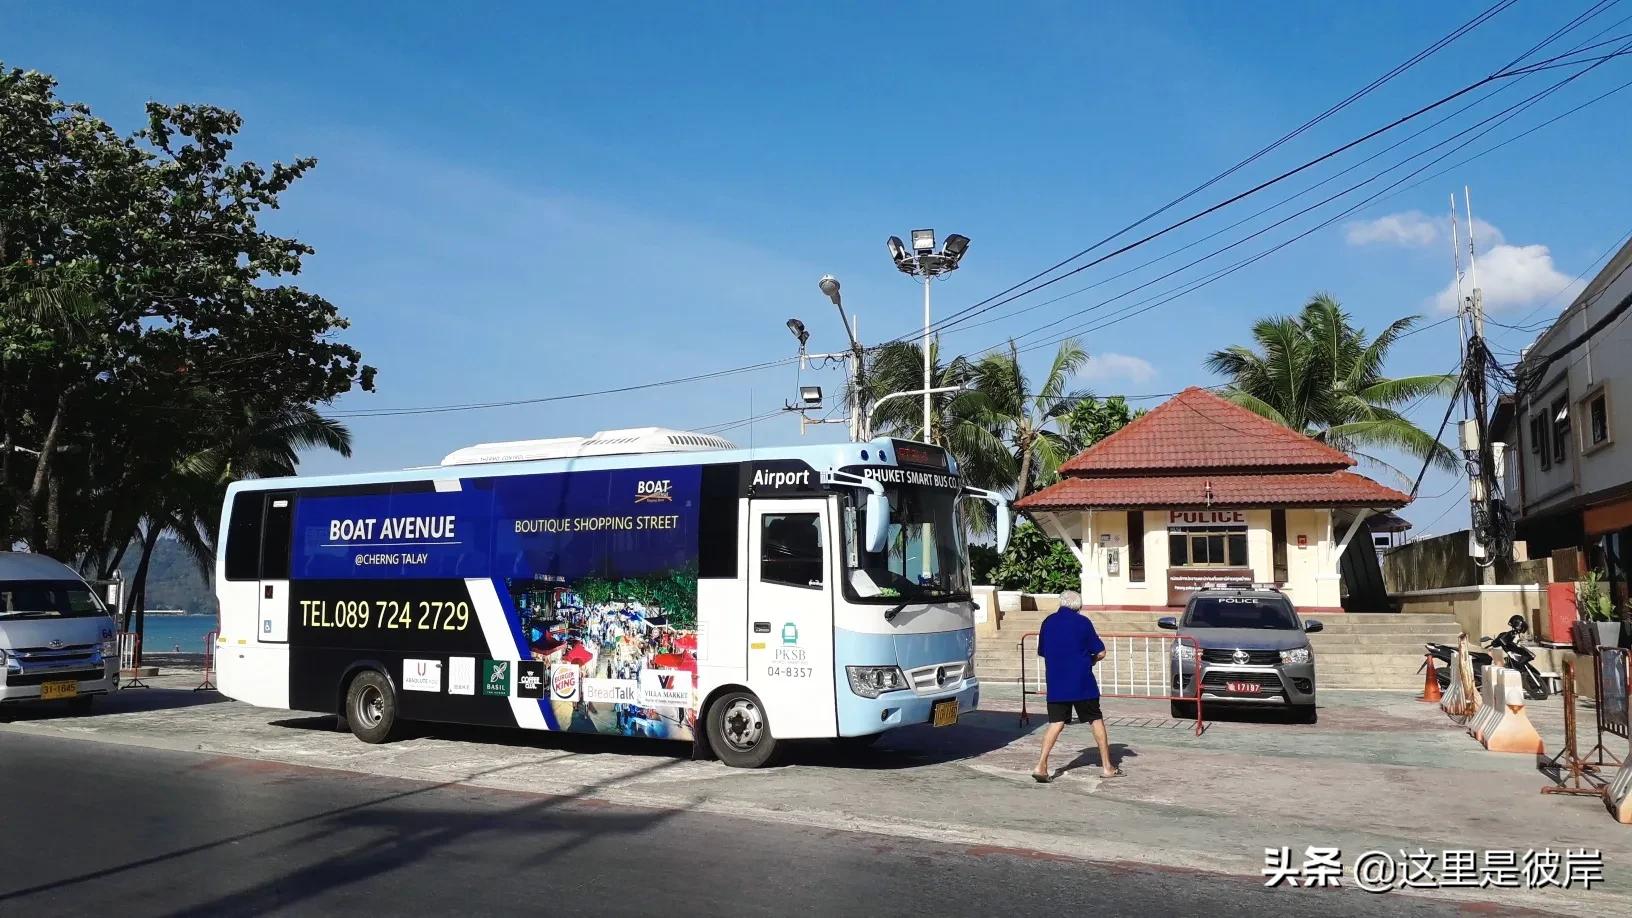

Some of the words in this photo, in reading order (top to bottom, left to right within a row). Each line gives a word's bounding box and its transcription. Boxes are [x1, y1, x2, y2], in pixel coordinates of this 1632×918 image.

[753, 469, 810, 488] Airport
[864, 469, 905, 483] PHUKET
[906, 471, 933, 486] SMART
[934, 474, 948, 488] BUS
[638, 480, 671, 494] BOAT
[1170, 510, 1245, 523] POLICE
[329, 519, 376, 541] BOAT
[379, 516, 456, 539] AVENUE
[515, 519, 571, 534] BOUTIQUE
[574, 517, 633, 531] SHOPPING
[636, 516, 679, 529] STREET
[355, 554, 399, 565] @CHERNG
[402, 553, 428, 565] TALAY
[300, 600, 370, 628] TEL.089
[376, 601, 412, 629] 724
[418, 602, 469, 631] 2729
[775, 649, 806, 660] PKSB
[554, 671, 575, 684] BURGER
[768, 666, 813, 678] 04-8357
[43, 684, 76, 695] 31-1645
[486, 683, 506, 691] BASIL
[555, 678, 576, 691] KING
[588, 686, 634, 700] BreadTalk
[645, 690, 661, 698] VILLA
[663, 691, 688, 699] MARKET
